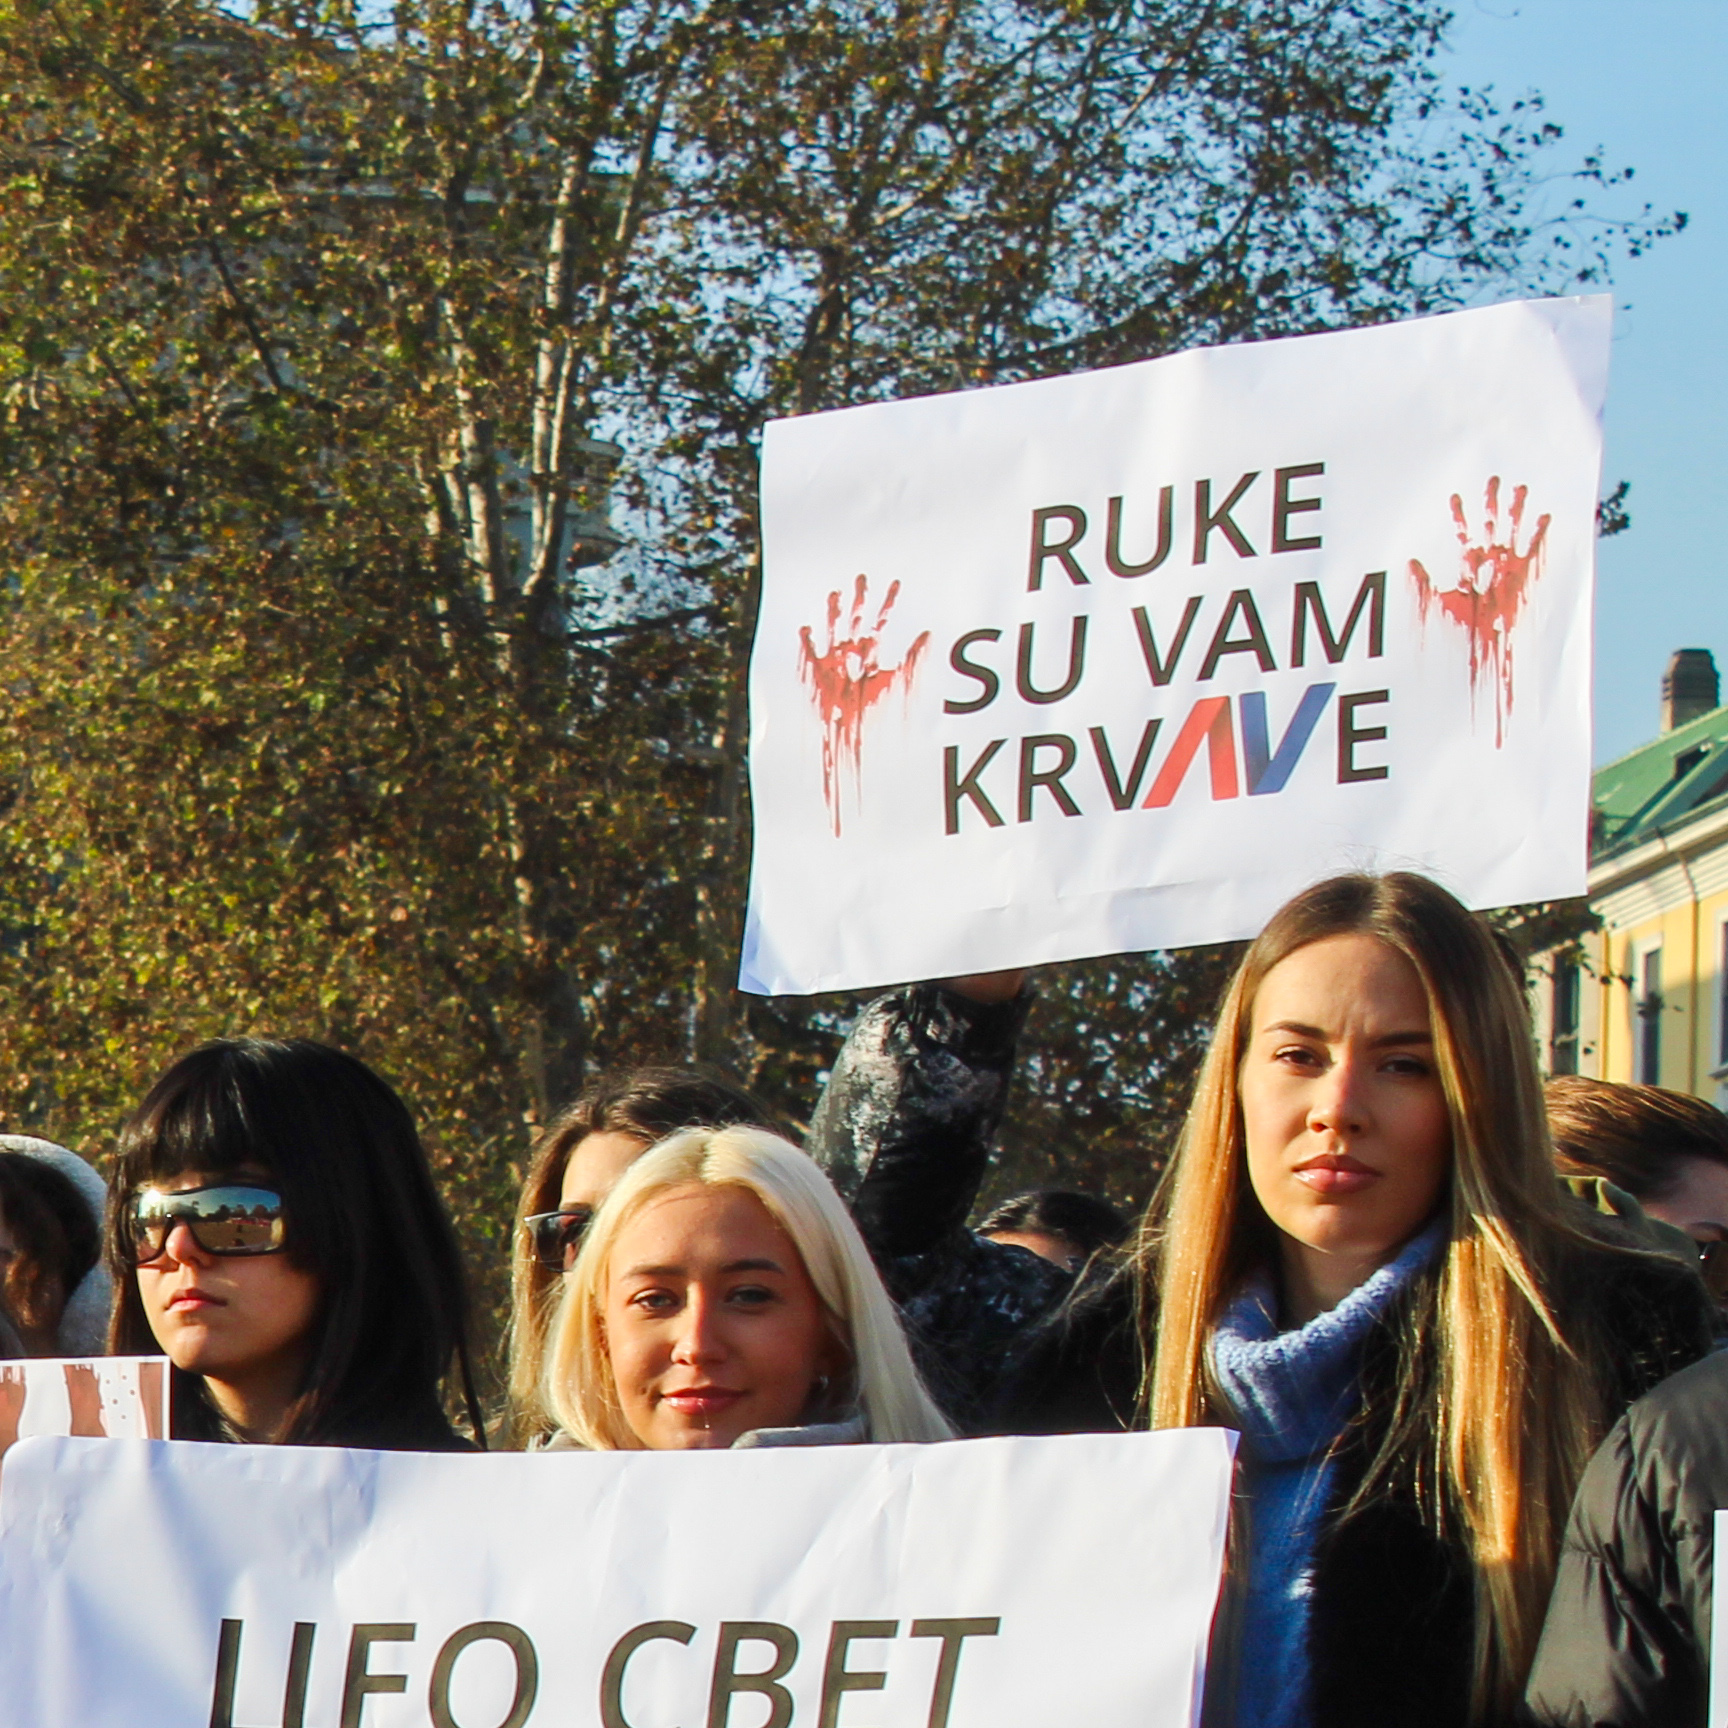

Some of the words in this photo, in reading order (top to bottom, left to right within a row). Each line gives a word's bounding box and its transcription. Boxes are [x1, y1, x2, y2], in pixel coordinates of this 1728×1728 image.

[1027, 461, 1326, 593] RUKE
[943, 613, 1089, 715] SU
[1132, 569, 1388, 688] VAM
[943, 680, 1390, 837] KRVAVE
